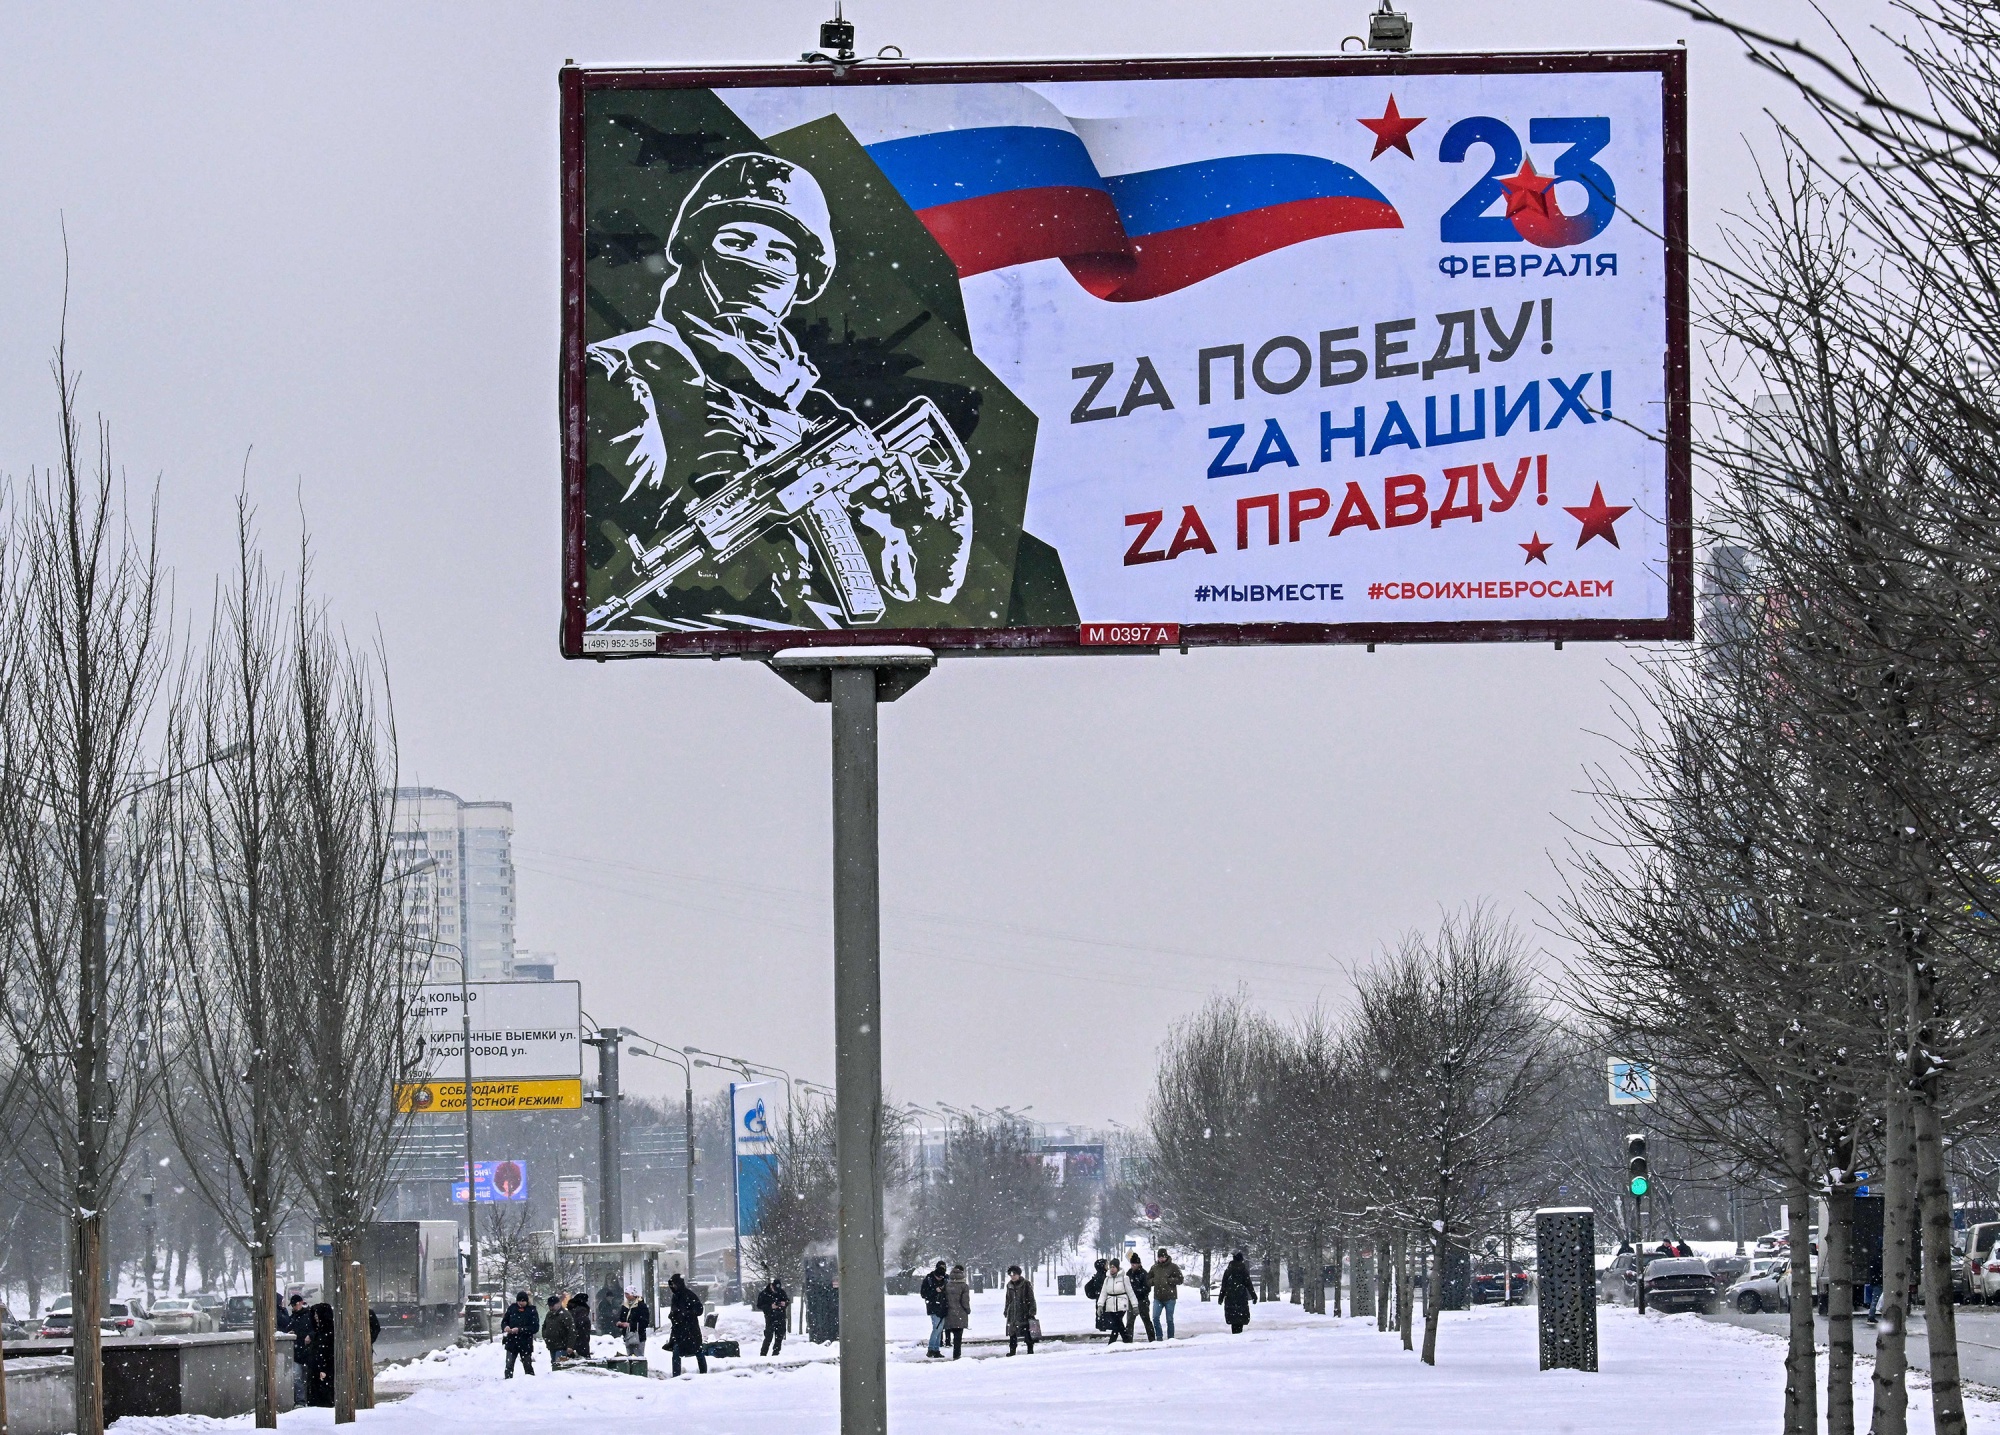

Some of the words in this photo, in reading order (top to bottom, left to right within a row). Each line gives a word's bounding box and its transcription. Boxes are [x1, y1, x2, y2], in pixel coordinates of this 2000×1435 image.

[1439, 115, 1616, 248] 23
[1438, 253, 1618, 278] ФЕВРАЛЯ
[1198, 298, 1554, 405] ПОБЕДУ!
[1319, 370, 1613, 462] НАШИХ!
[1236, 454, 1549, 550] ПРАВДУ!
[1194, 583, 1345, 602] #МЫВМЕСТЕ
[1367, 580, 1615, 600] #СВОИХНЕБРОСАЕМ
[611, 638, 653, 648] 952-35-58
[1089, 627, 1105, 641] М
[1110, 627, 1152, 641] 0397
[1156, 627, 1169, 641] А
[505, 1030, 557, 1041] ВЫЕМКИ
[559, 1032, 577, 1042] ул.
[511, 1048, 527, 1057] ул.
[518, 1096, 564, 1105] РЕЖИМ!
